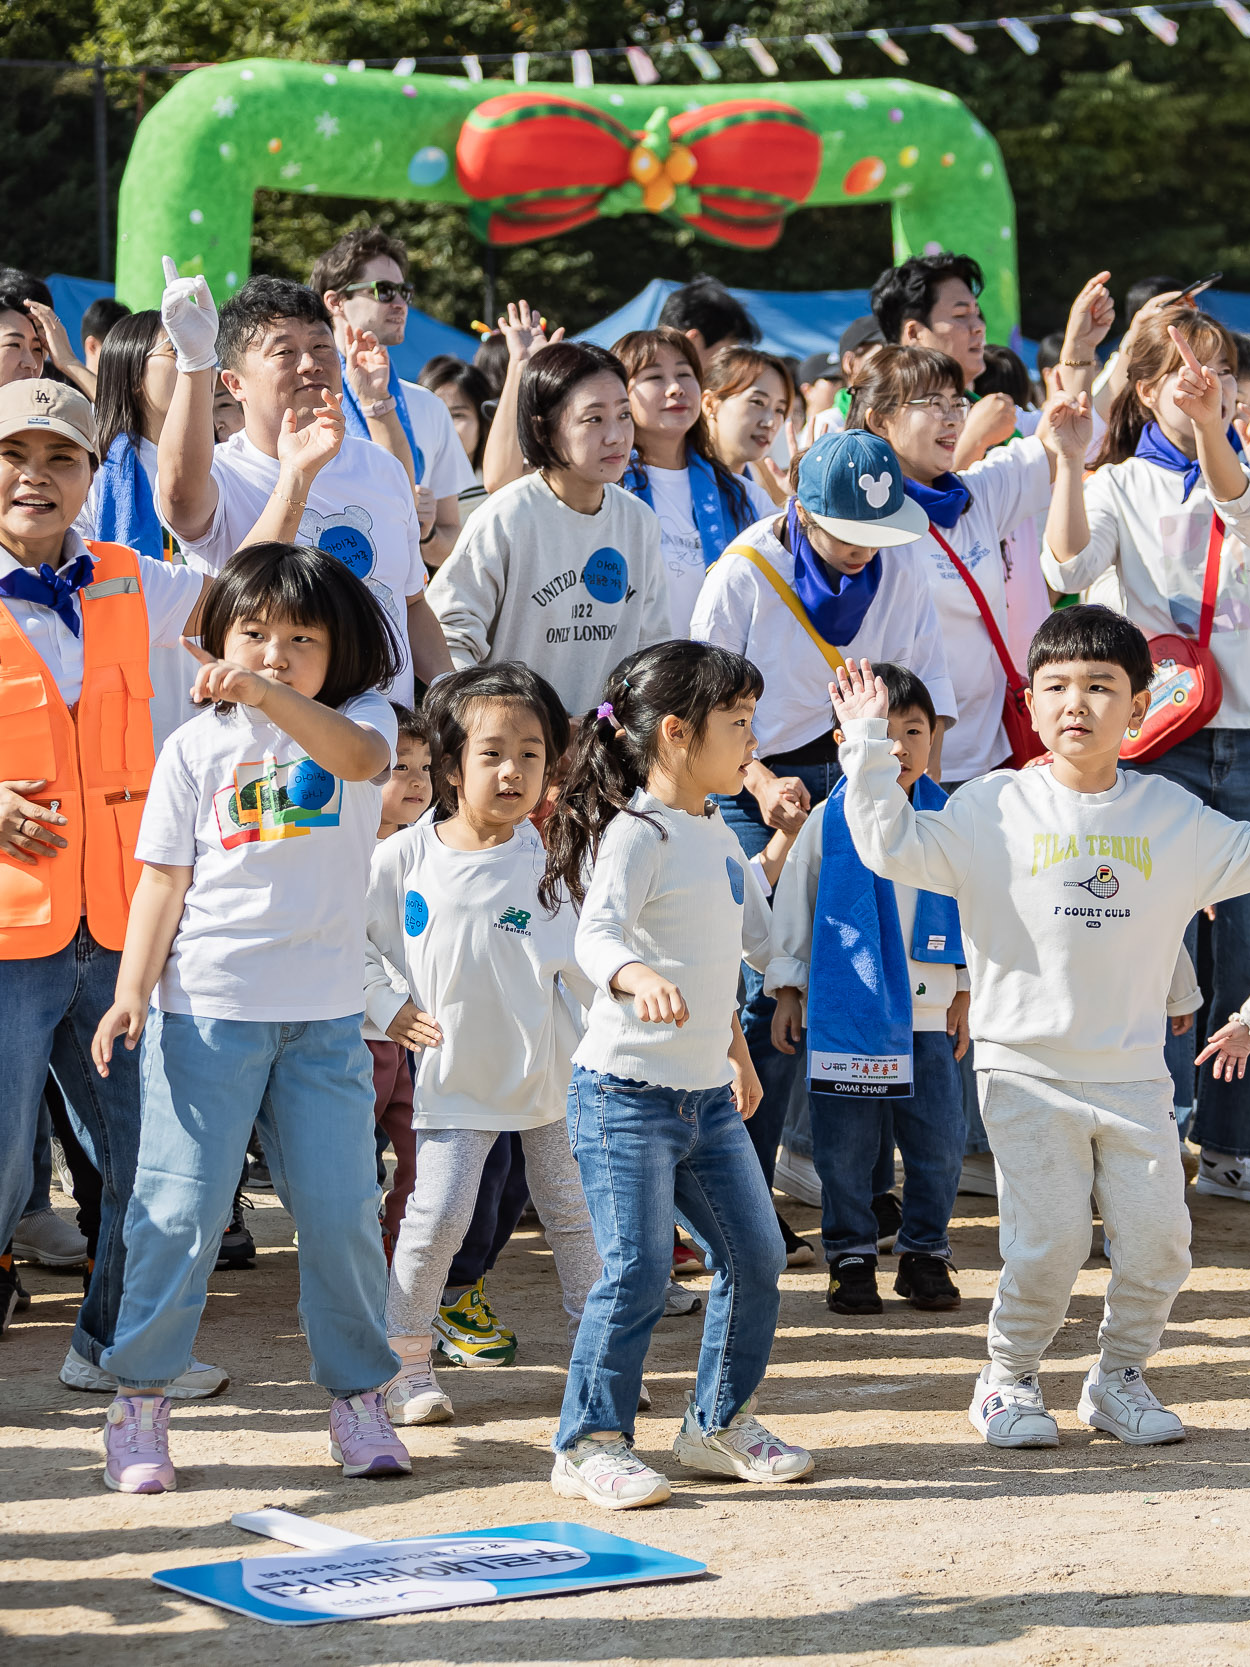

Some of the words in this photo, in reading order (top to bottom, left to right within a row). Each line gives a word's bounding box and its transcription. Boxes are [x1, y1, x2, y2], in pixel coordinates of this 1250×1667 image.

[35, 390, 50, 403] LA
[531, 569, 577, 607] UNITED
[300, 788, 325, 801] 하나
[1031, 833, 1080, 877] FILA
[1085, 834, 1153, 881] TENNIS
[1053, 906, 1062, 915] F
[1064, 907, 1103, 918] COURT
[1104, 908, 1131, 918] CULB
[834, 1083, 860, 1093] OMAR
[861, 1085, 888, 1094] SHARIF
[253, 1548, 588, 1598] 푸르내어린이집
